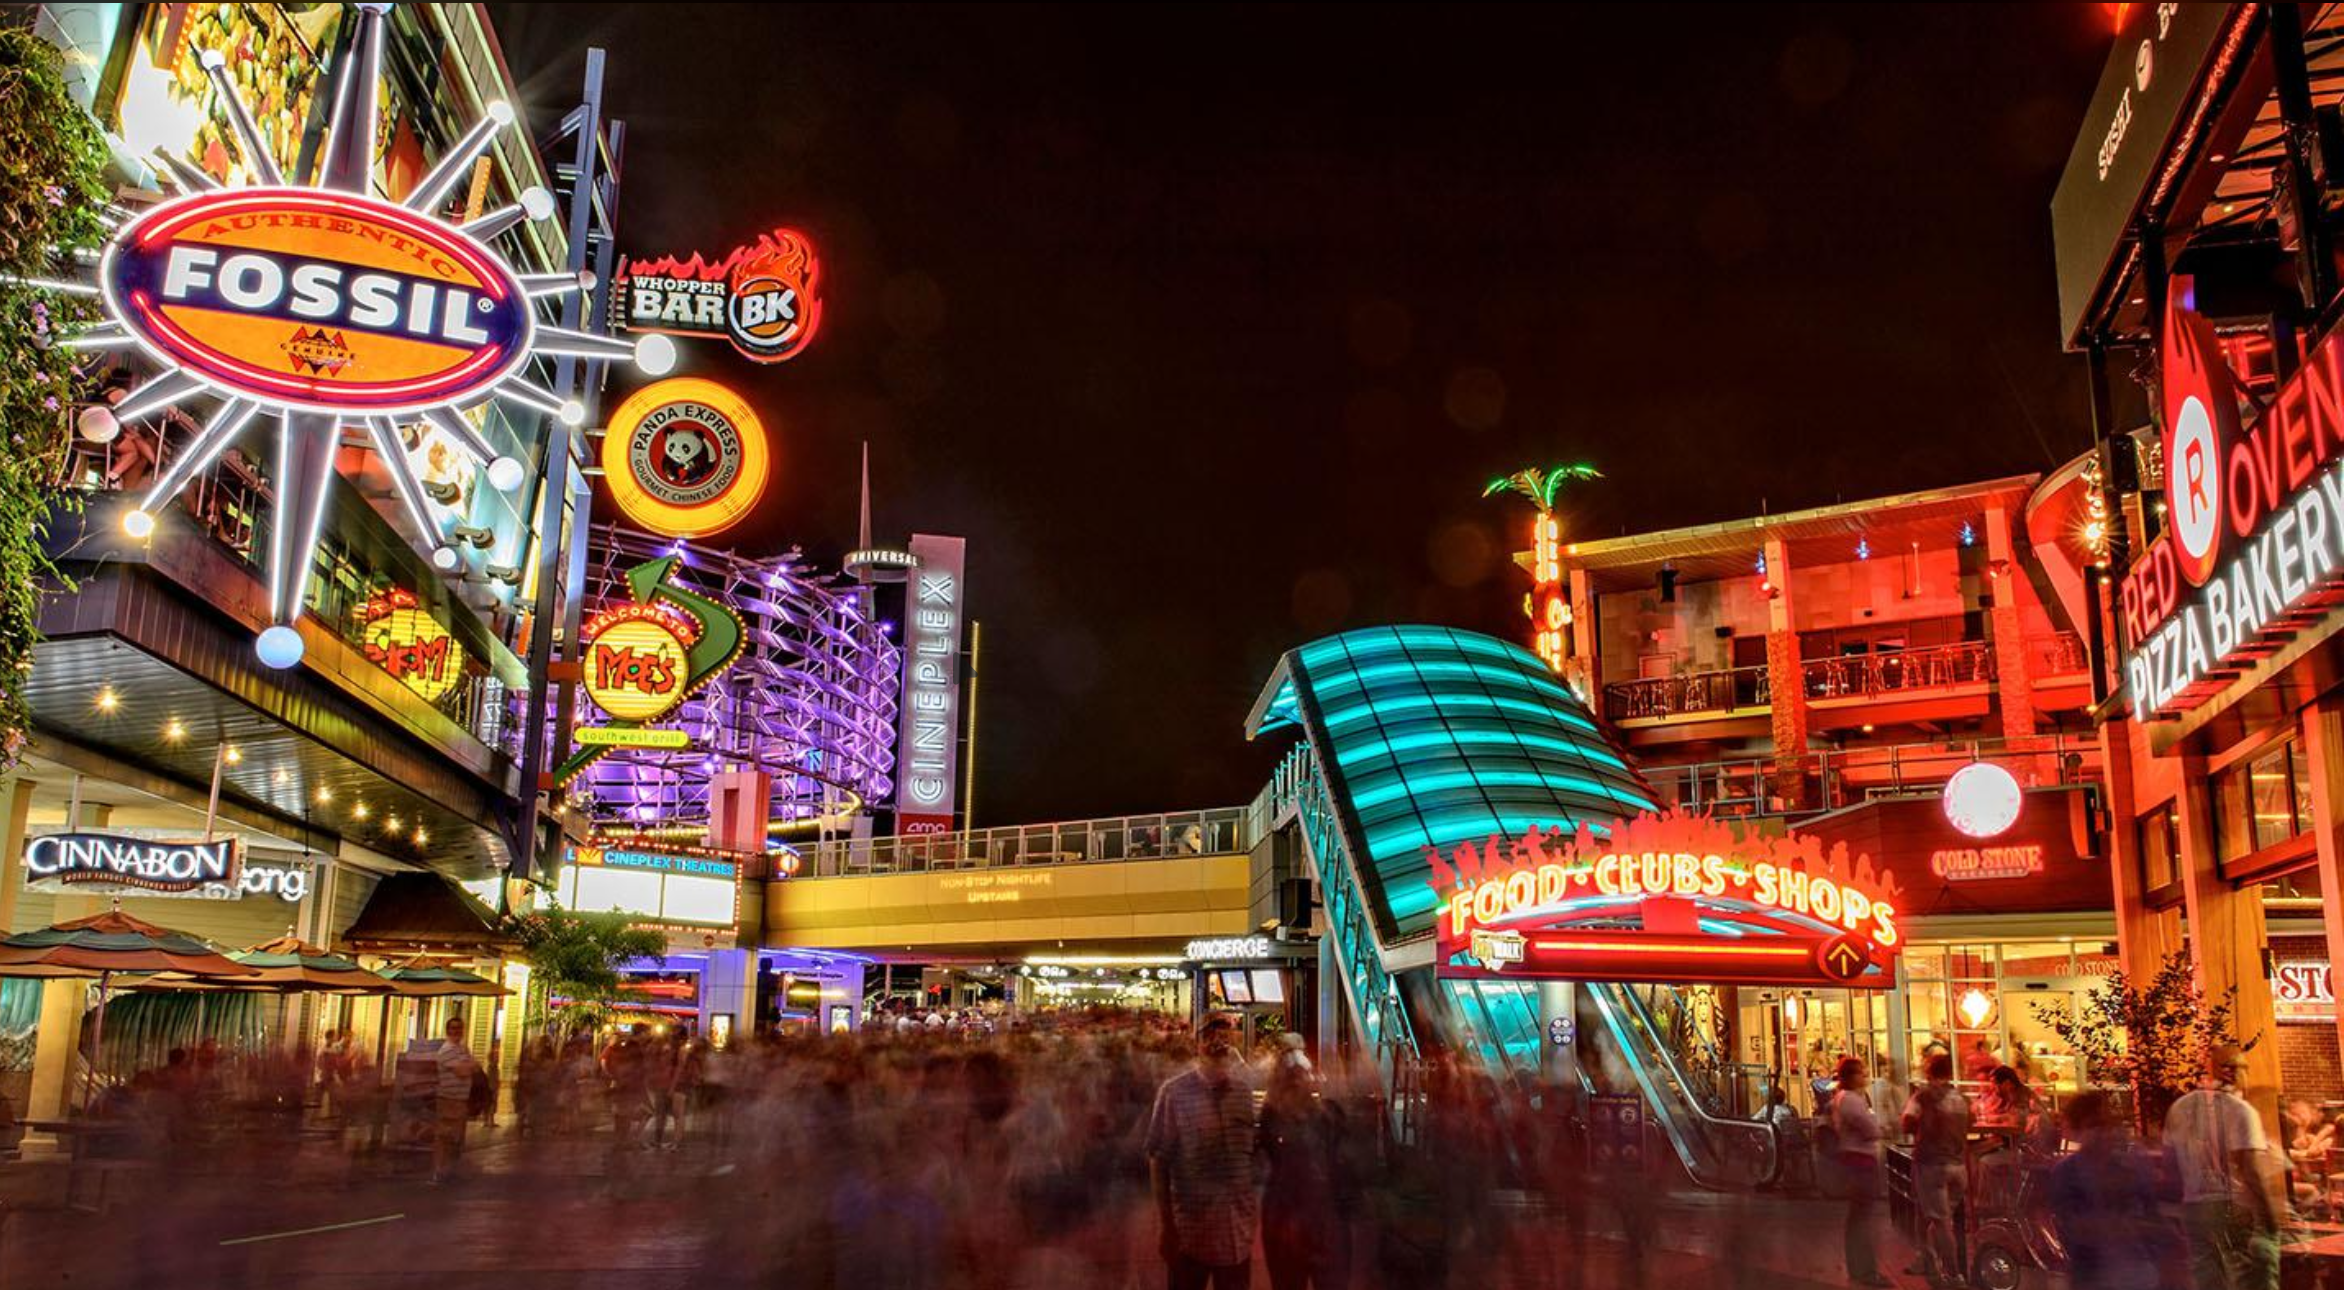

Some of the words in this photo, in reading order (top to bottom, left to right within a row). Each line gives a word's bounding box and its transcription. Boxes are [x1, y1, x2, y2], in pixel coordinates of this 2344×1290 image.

[2098, 87, 2132, 182] SUSHI
[202, 212, 458, 279] AUTHENTIC
[163, 246, 490, 344] FOSSIL
[632, 275, 726, 296] WHOPPER
[632, 288, 726, 327] BAR
[742, 288, 796, 329] BK
[634, 407, 679, 451] PANDA
[685, 405, 737, 456] EXPRESS
[634, 459, 668, 498] GOURMET
[671, 489, 713, 501] CHINESE
[714, 464, 735, 490] FOOD
[2121, 538, 2176, 648] RED
[2228, 335, 2344, 538] OVEN
[851, 550, 918, 567] UNIVERSAL
[2130, 604, 2208, 722] PIZZA
[2205, 470, 2344, 660] BAKERY
[587, 605, 665, 635] WELCOME
[669, 620, 689, 637] TO
[911, 574, 953, 804] CINEPLEX
[583, 730, 648, 742] southwest
[651, 734, 680, 743] grill
[27, 836, 229, 880] CINNABON
[604, 849, 672, 868] CINEPLEX
[674, 857, 735, 876] THEATRES
[1931, 850, 1980, 876] COLD
[1981, 846, 2043, 872] STONE
[1452, 864, 1566, 936] FOOD
[1595, 852, 1726, 896] CLUBS
[1753, 862, 1898, 947] SHOPS
[1187, 937, 1269, 958] CONCIERGE
[2055, 963, 2084, 977] COD
